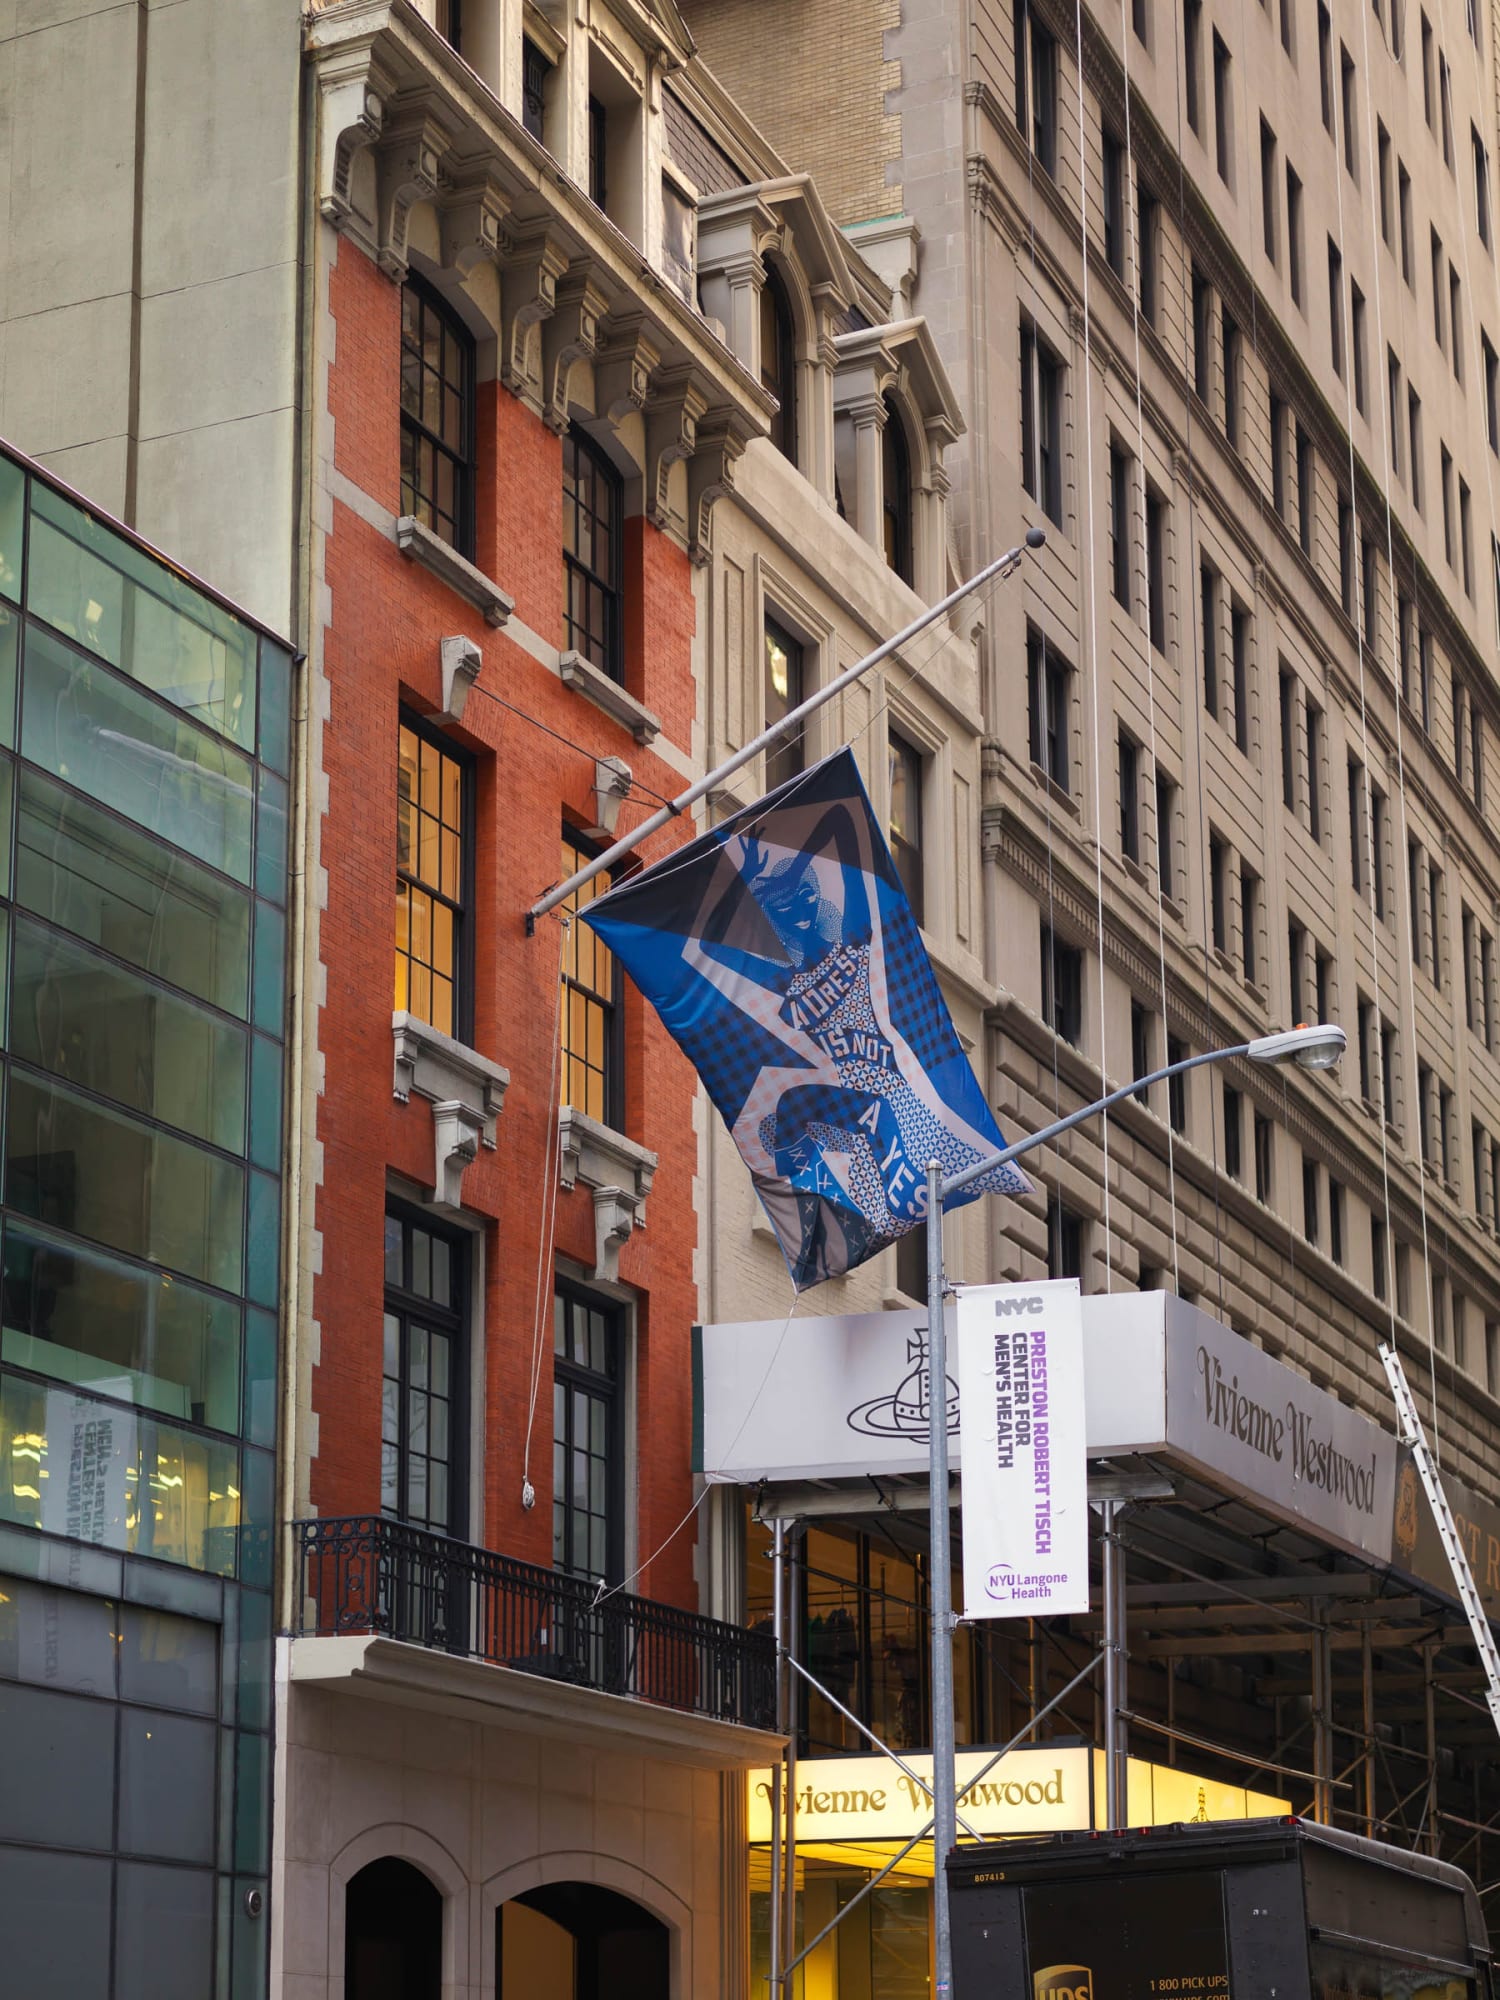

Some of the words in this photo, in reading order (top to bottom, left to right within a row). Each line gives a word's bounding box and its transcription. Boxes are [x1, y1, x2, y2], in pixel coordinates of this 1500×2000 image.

[818, 1028, 850, 1058] IS
[853, 1033, 891, 1067] NOT
[858, 1100, 881, 1135] A
[880, 1135, 929, 1219] YES
[995, 1297, 1044, 1317] NYC
[994, 1334, 1011, 1392] MEN'S
[1012, 1332, 1030, 1405] CENTER
[1030, 1331, 1048, 1418] PRESTON
[996, 1396, 1014, 1468] HEALTH
[1015, 1409, 1031, 1447] FOR
[1197, 1345, 1285, 1463] Vivienne
[1285, 1401, 1377, 1515] Westwood
[1033, 1422, 1051, 1496] ROBERT
[1035, 1500, 1051, 1554] TISCH
[990, 1574, 1015, 1588] NYU
[1017, 1573, 1068, 1587] Langone
[1011, 1586, 1052, 1600] Health
[897, 1769, 1065, 1813] Wstwood
[974, 1872, 1006, 1883] 807413
[1150, 1980, 1155, 1991] 1
[1159, 1978, 1179, 1991] 800
[1181, 1977, 1205, 1990] PICK
[1207, 1975, 1229, 1988] UPS
